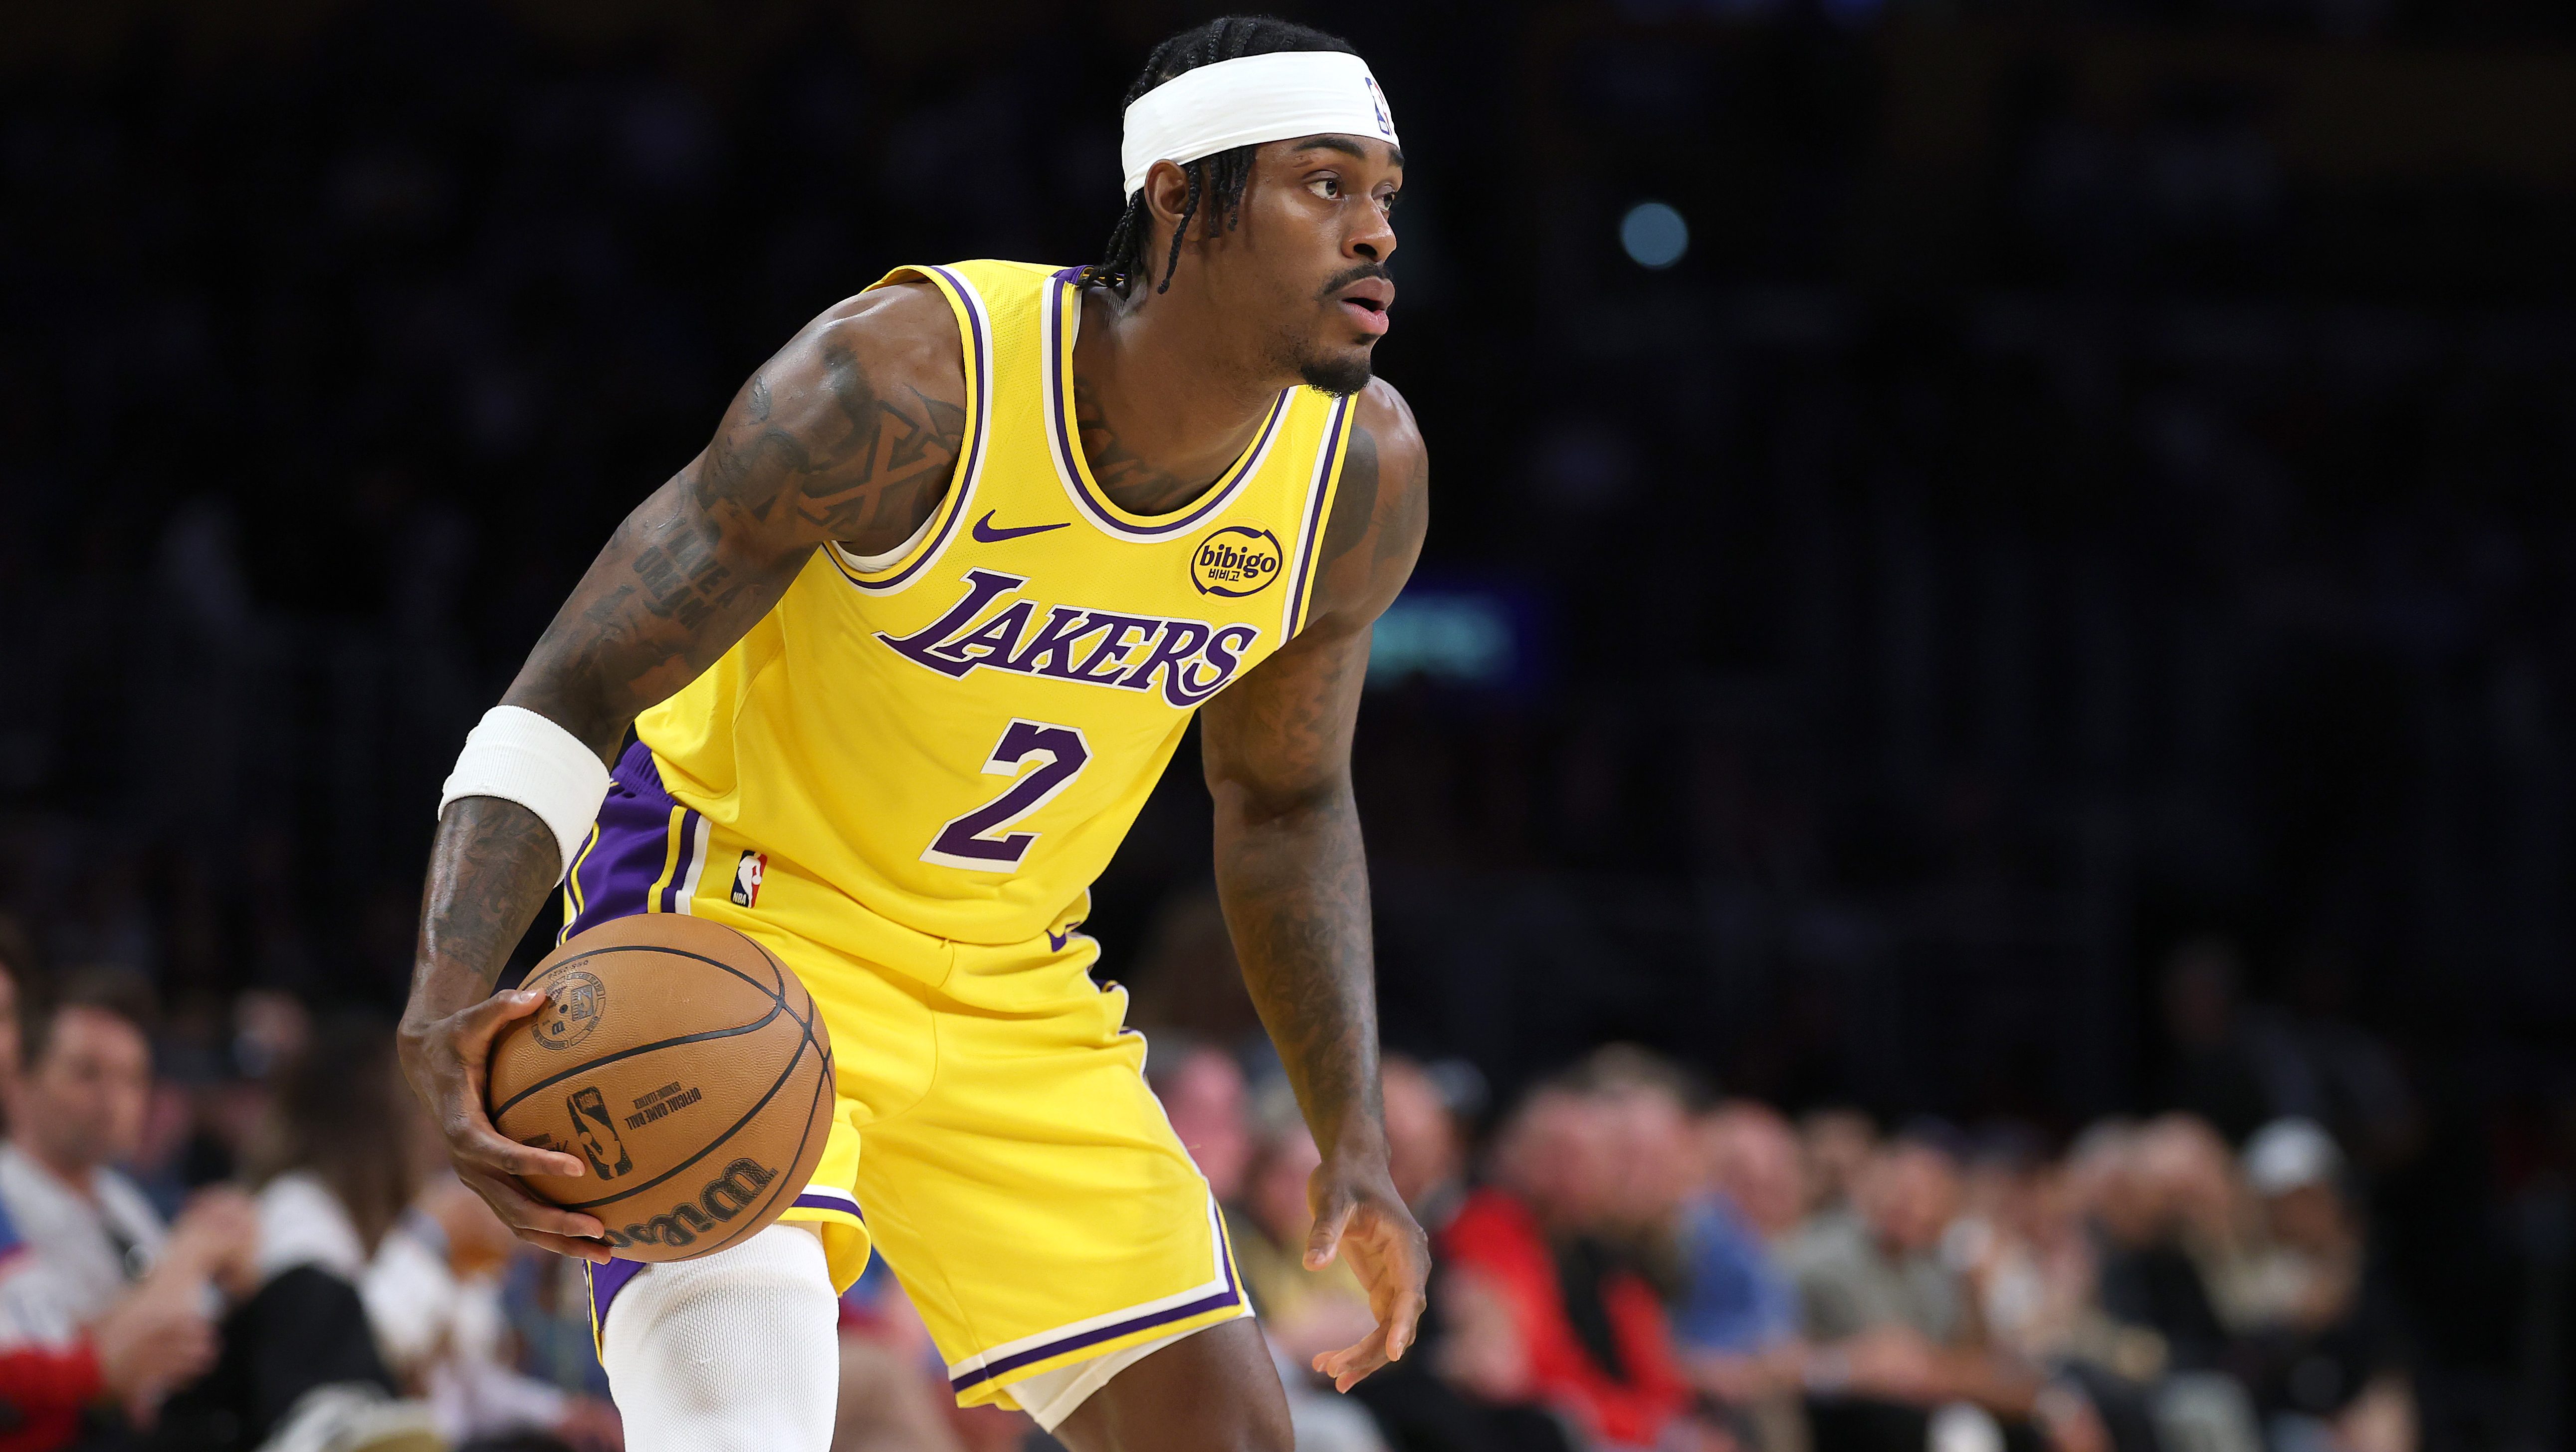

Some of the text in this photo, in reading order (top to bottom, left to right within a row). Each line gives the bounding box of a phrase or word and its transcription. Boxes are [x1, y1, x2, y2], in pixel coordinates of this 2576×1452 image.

[1200, 544, 1276, 578] bibigo
[1208, 568, 1241, 582] 비비고
[871, 567, 1261, 709] LAKERS
[919, 717, 1093, 873] 2
[732, 891, 747, 905] NBA
[624, 1087, 701, 1130] OFFICIAL GAME BALL
[604, 1157, 778, 1248] Wilso
